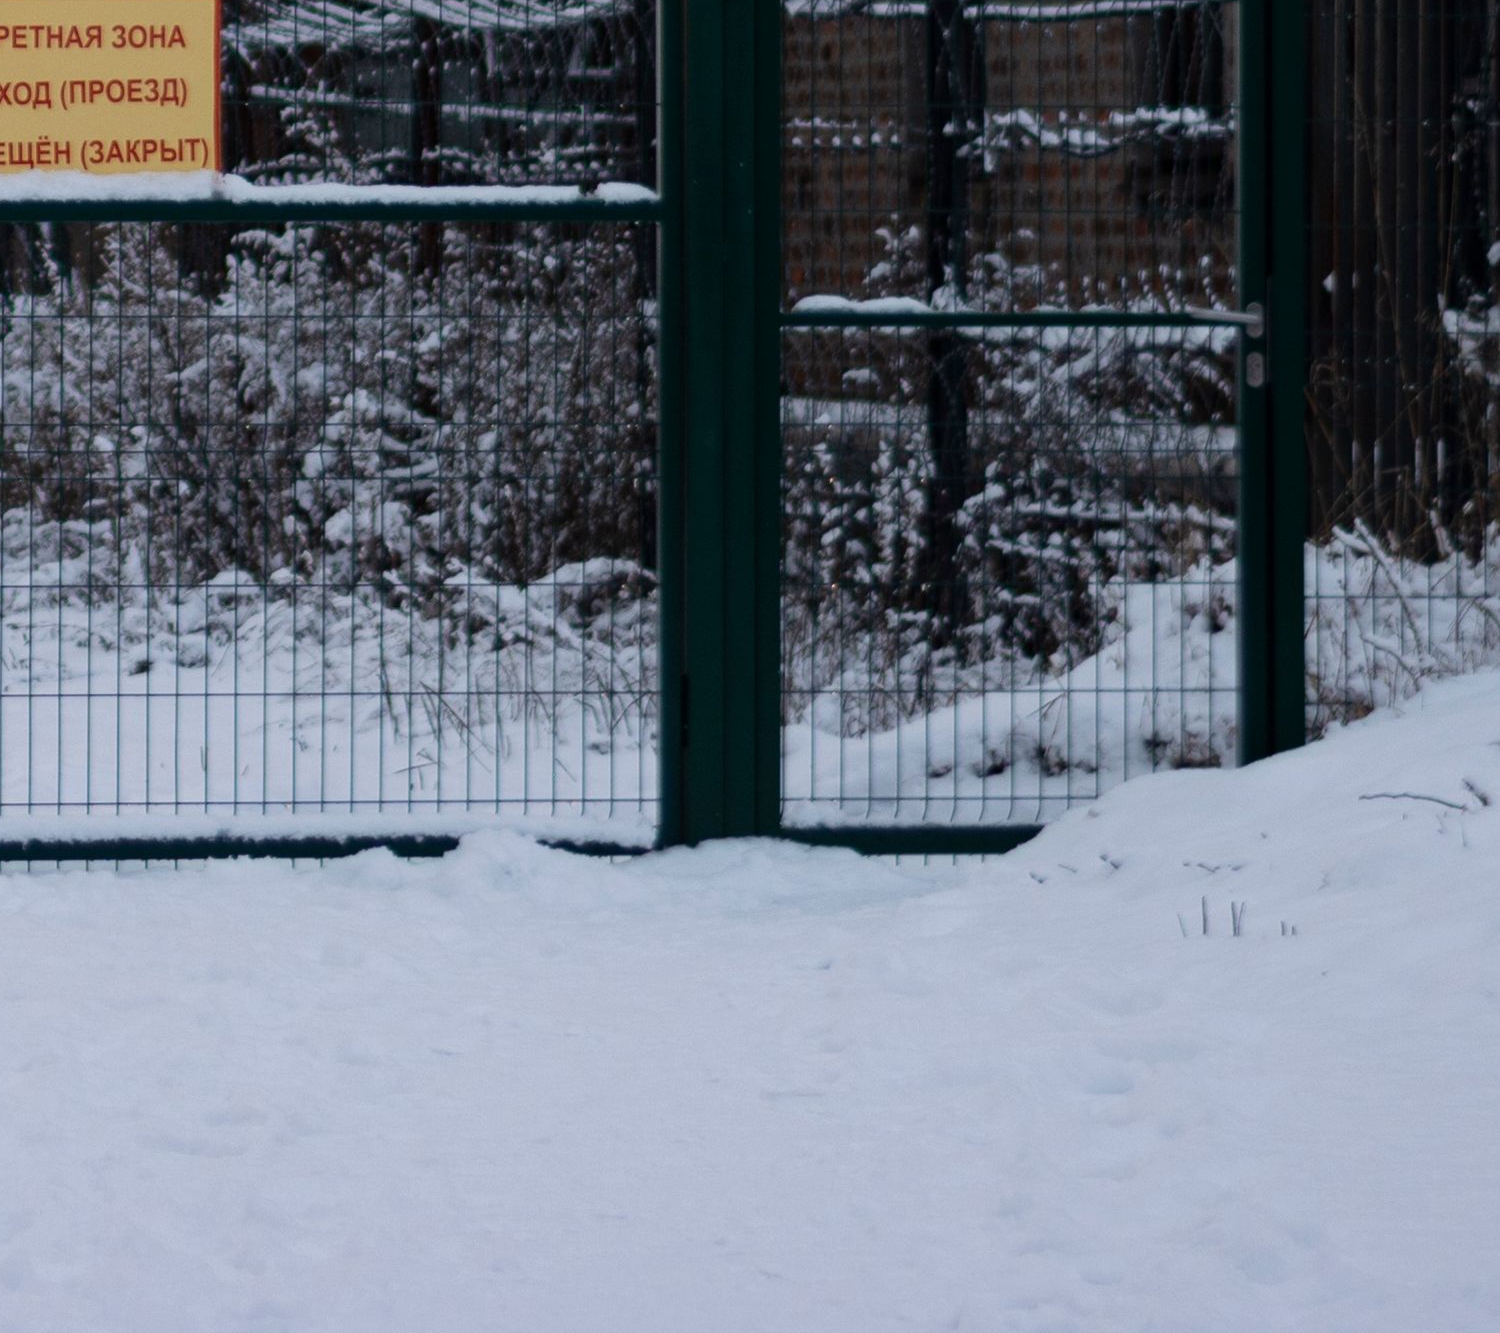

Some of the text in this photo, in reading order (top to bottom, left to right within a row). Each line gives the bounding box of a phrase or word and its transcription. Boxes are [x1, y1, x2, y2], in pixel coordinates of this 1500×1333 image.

[112, 24, 186, 49] ЗОНА
[60, 78, 187, 109] (ПРОЕЗД)
[80, 138, 209, 170] (ЗАКРЫТ)
